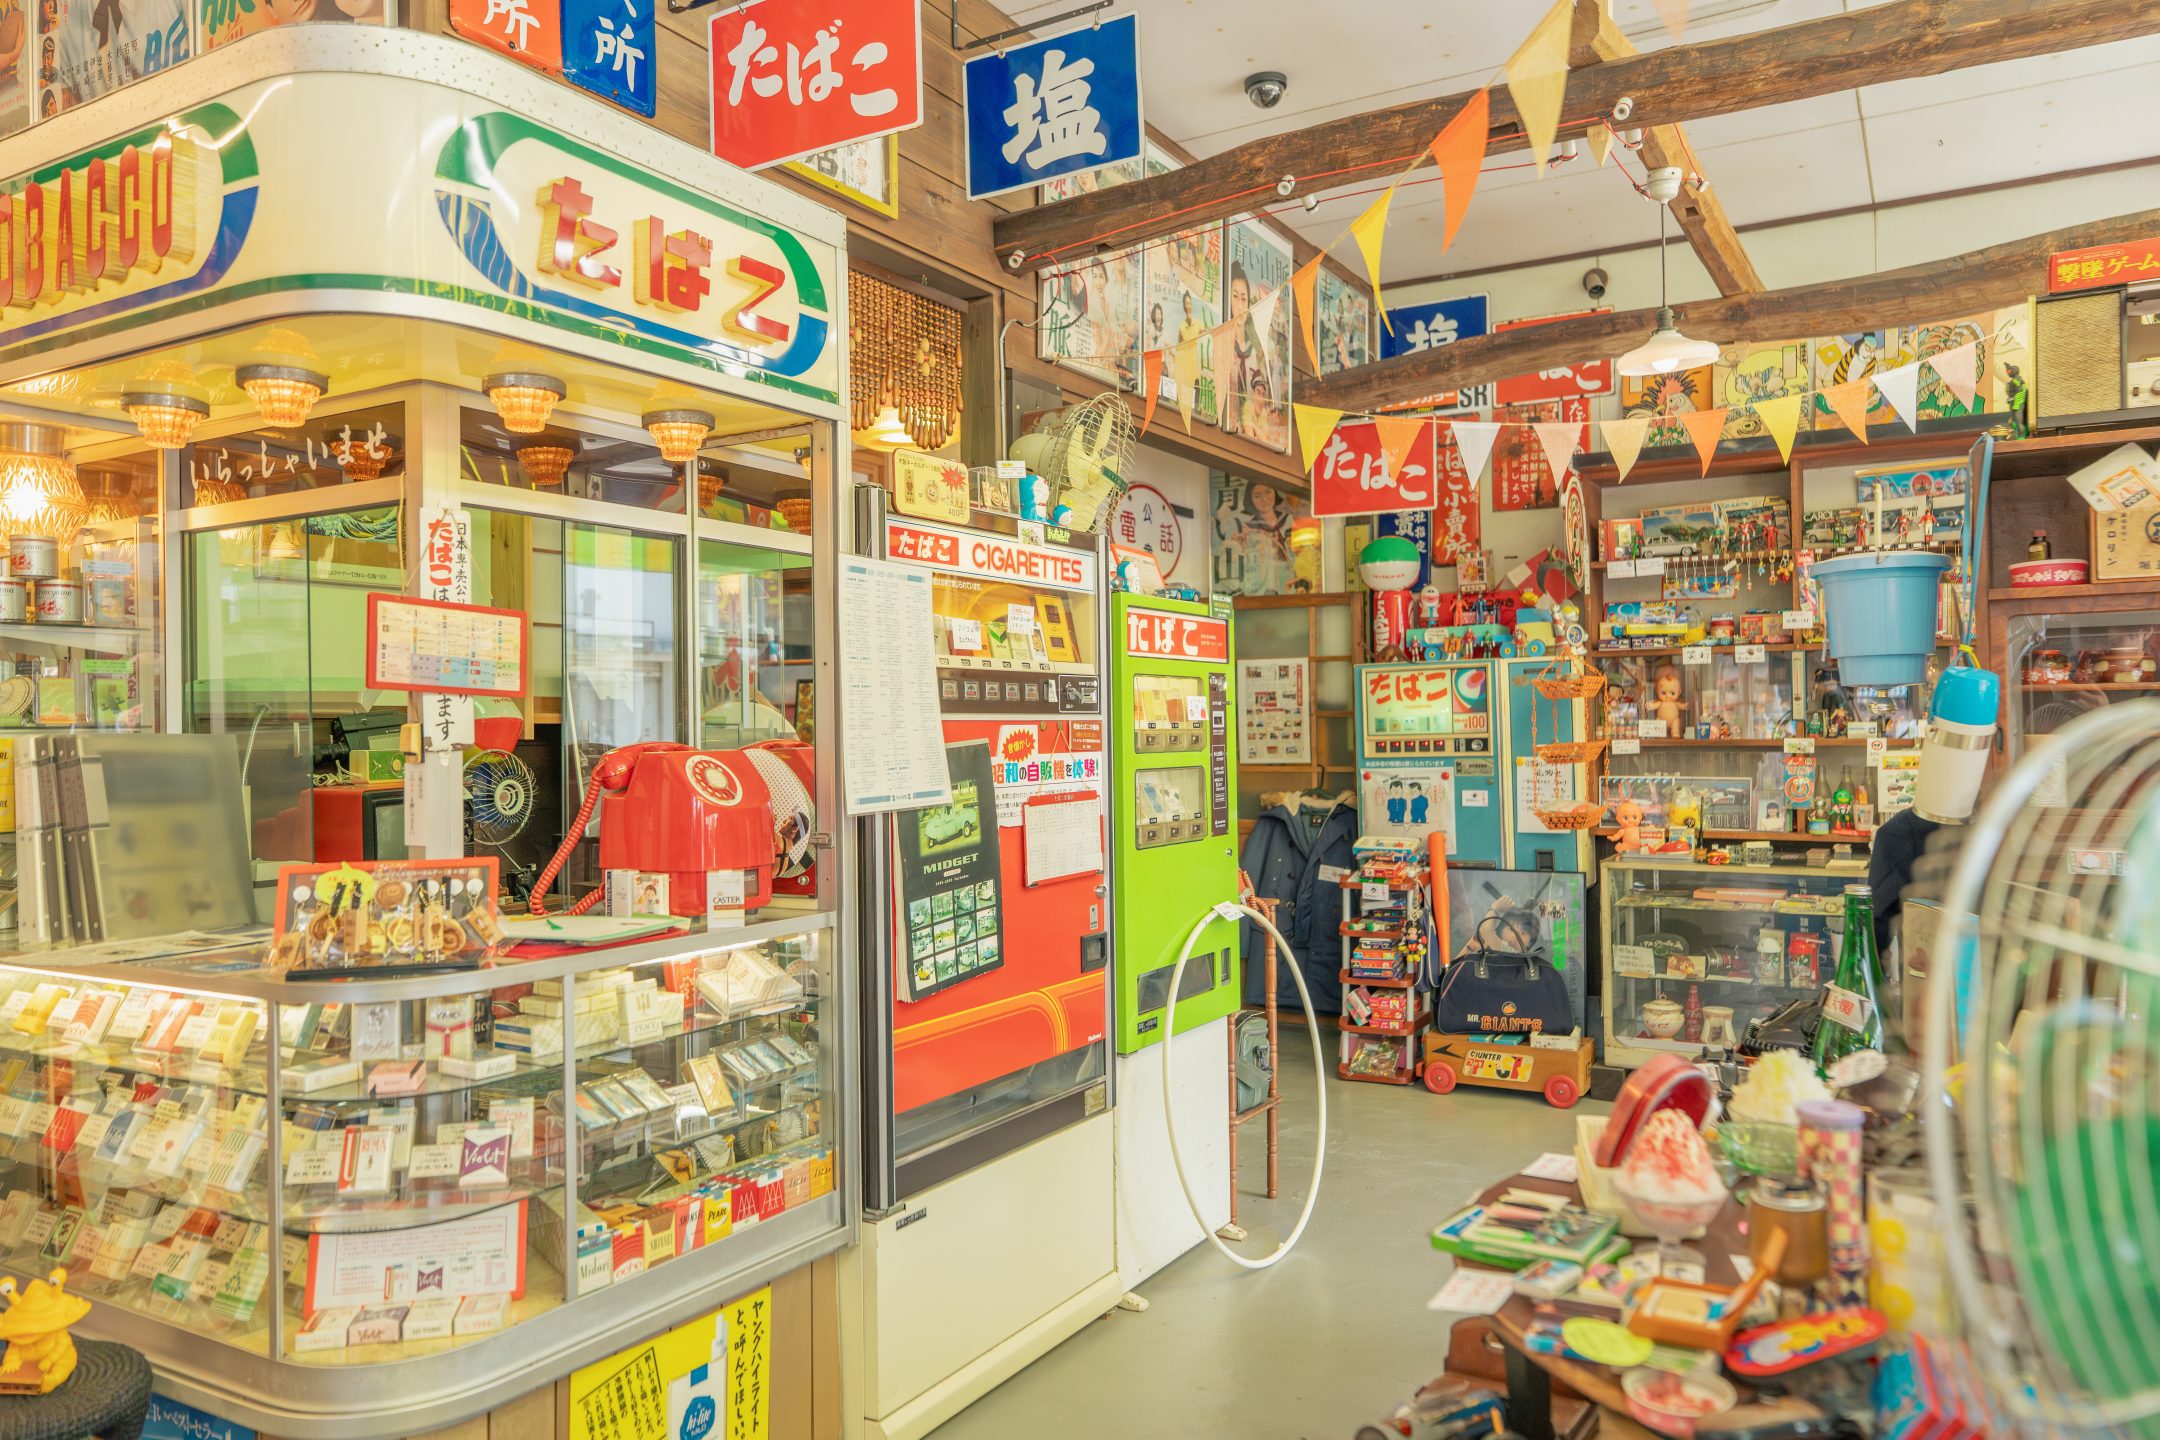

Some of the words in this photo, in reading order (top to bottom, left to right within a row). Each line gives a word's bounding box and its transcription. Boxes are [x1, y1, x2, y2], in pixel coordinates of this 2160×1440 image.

[728, 20, 899, 117] たばこ
[1002, 50, 1107, 170] 塩
[545, 176, 790, 343] たばこ
[190, 421, 387, 489] いらっしゃいませ
[1323, 434, 1428, 502] たばこ
[898, 531, 951, 562] たばこ
[972, 542, 1082, 583] CIGARETTES
[2106, 516, 2117, 566] ケロリン
[1128, 614, 1199, 656] たばこ
[1370, 672, 1448, 705] たばこ
[924, 853, 979, 875] MIDGET
[713, 896, 741, 904] CASTER
[1467, 1014, 1481, 1023] MR.
[1481, 1016, 1543, 1032] GIANTS
[464, 1148, 506, 1167] Violet
[579, 1257, 610, 1279] Midori
[615, 1256, 643, 1279] echo
[734, 1308, 747, 1440] と、呼んでほしい。
[752, 1300, 765, 1434] ヤングハイライト
[686, 1407, 713, 1433] hi-lite
